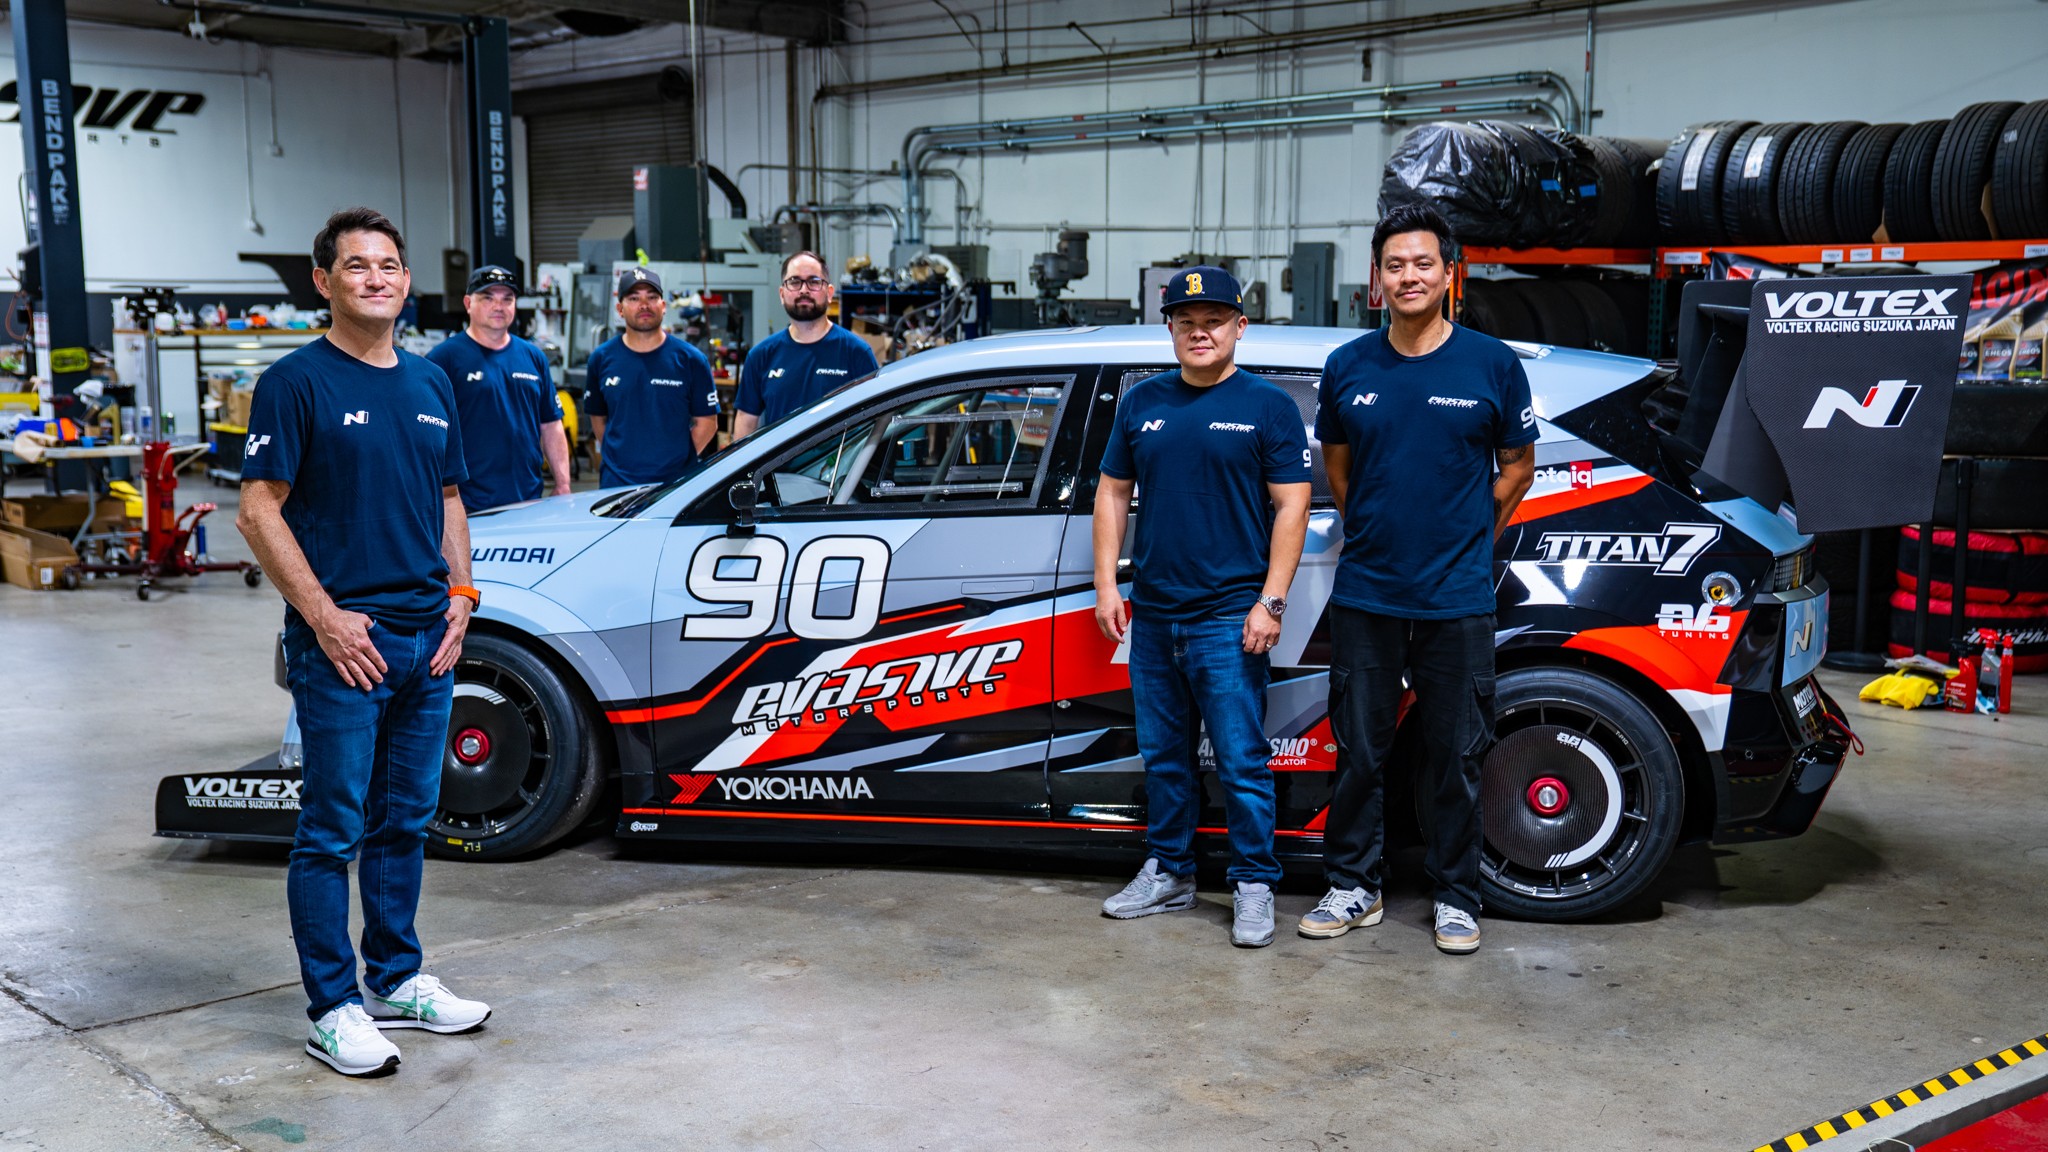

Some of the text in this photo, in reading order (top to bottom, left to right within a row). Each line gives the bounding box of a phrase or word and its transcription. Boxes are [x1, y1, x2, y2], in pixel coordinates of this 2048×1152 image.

[41, 79, 69, 204] BENDPAK
[488, 110, 507, 219] BENDPAK
[1185, 273, 1203, 296] B
[1765, 288, 1958, 318] VOLTEX
[1767, 318, 1956, 333] VOLTEX RACING SUZUKA JAPAN
[1534, 465, 1592, 489] otoiq
[471, 548, 555, 564] UNDAI
[1541, 524, 1719, 574] TITAN7
[680, 534, 892, 641] 90
[1659, 630, 1729, 640] TUNING
[742, 681, 996, 737] MOTORSPORTS
[184, 777, 304, 798] VOLTEX
[716, 777, 874, 800] YOKOHAMA
[187, 798, 303, 811] VOLTEX RACING SUZUKA JAPA
